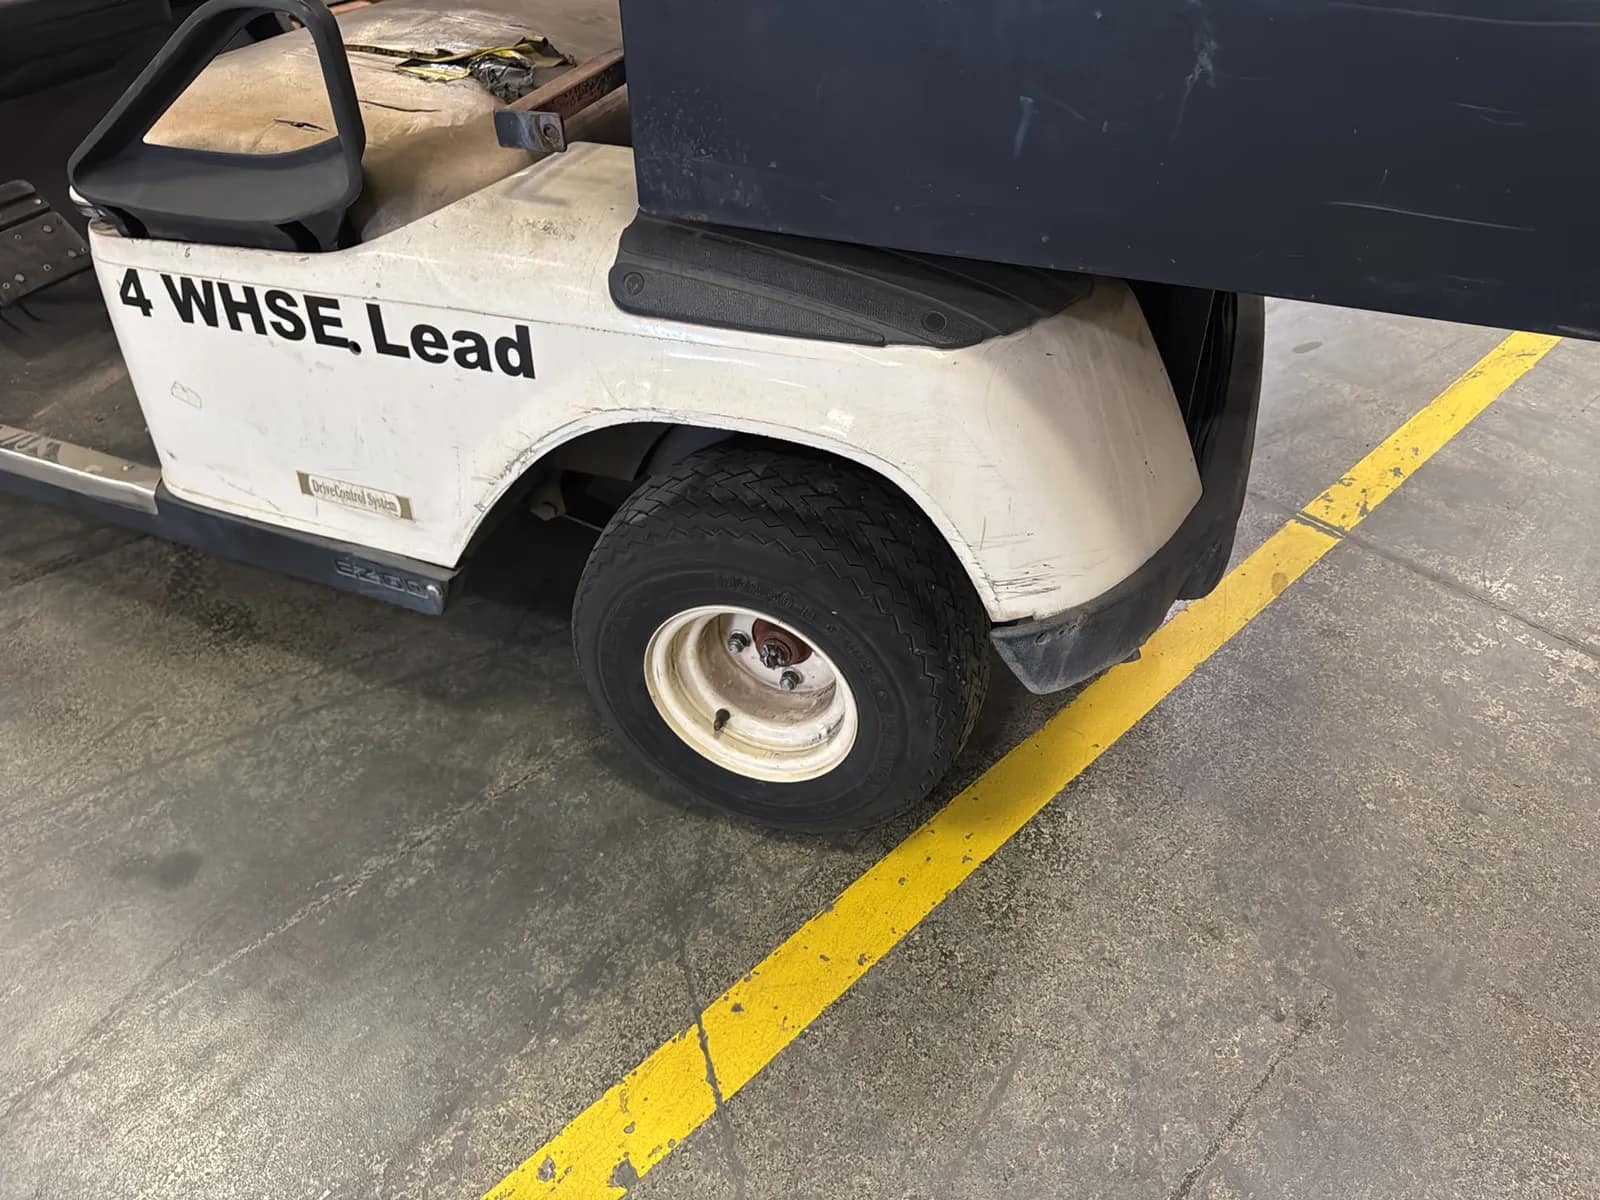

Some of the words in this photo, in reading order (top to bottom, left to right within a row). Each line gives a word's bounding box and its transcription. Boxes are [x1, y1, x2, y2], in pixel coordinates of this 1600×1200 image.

[119, 268, 153, 317] 4
[366, 303, 536, 379] Lead
[365, 491, 398, 513] System
